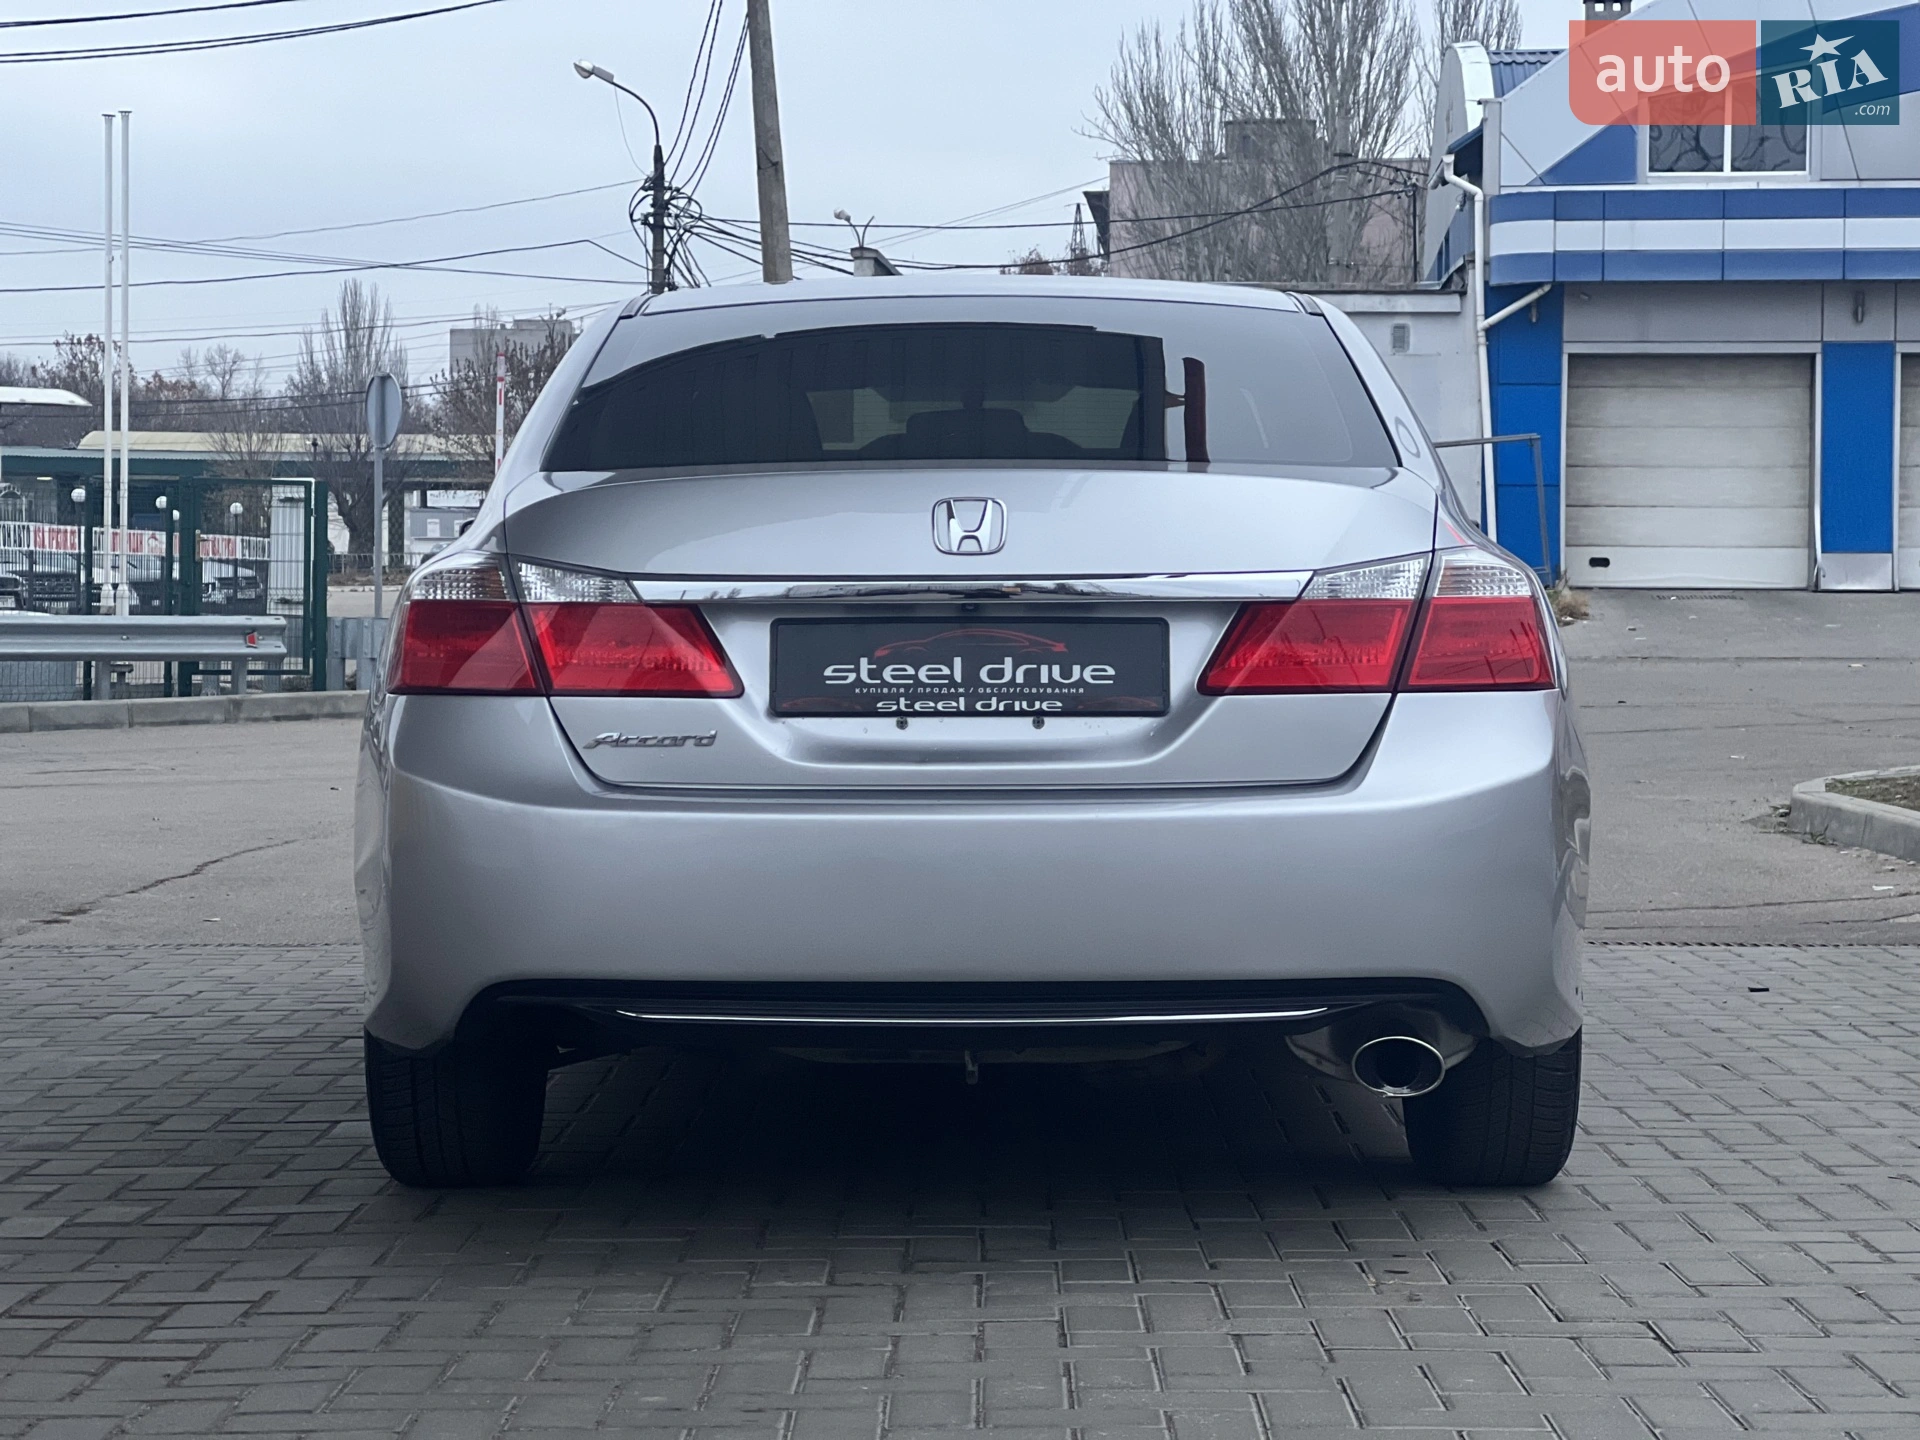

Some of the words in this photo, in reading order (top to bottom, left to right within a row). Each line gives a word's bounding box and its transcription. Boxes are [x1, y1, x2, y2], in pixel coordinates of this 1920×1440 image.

[823, 656, 961, 684] steel
[979, 656, 1116, 684] drive
[876, 696, 965, 712] steel
[975, 696, 1063, 712] drive
[583, 730, 718, 749] Accord
